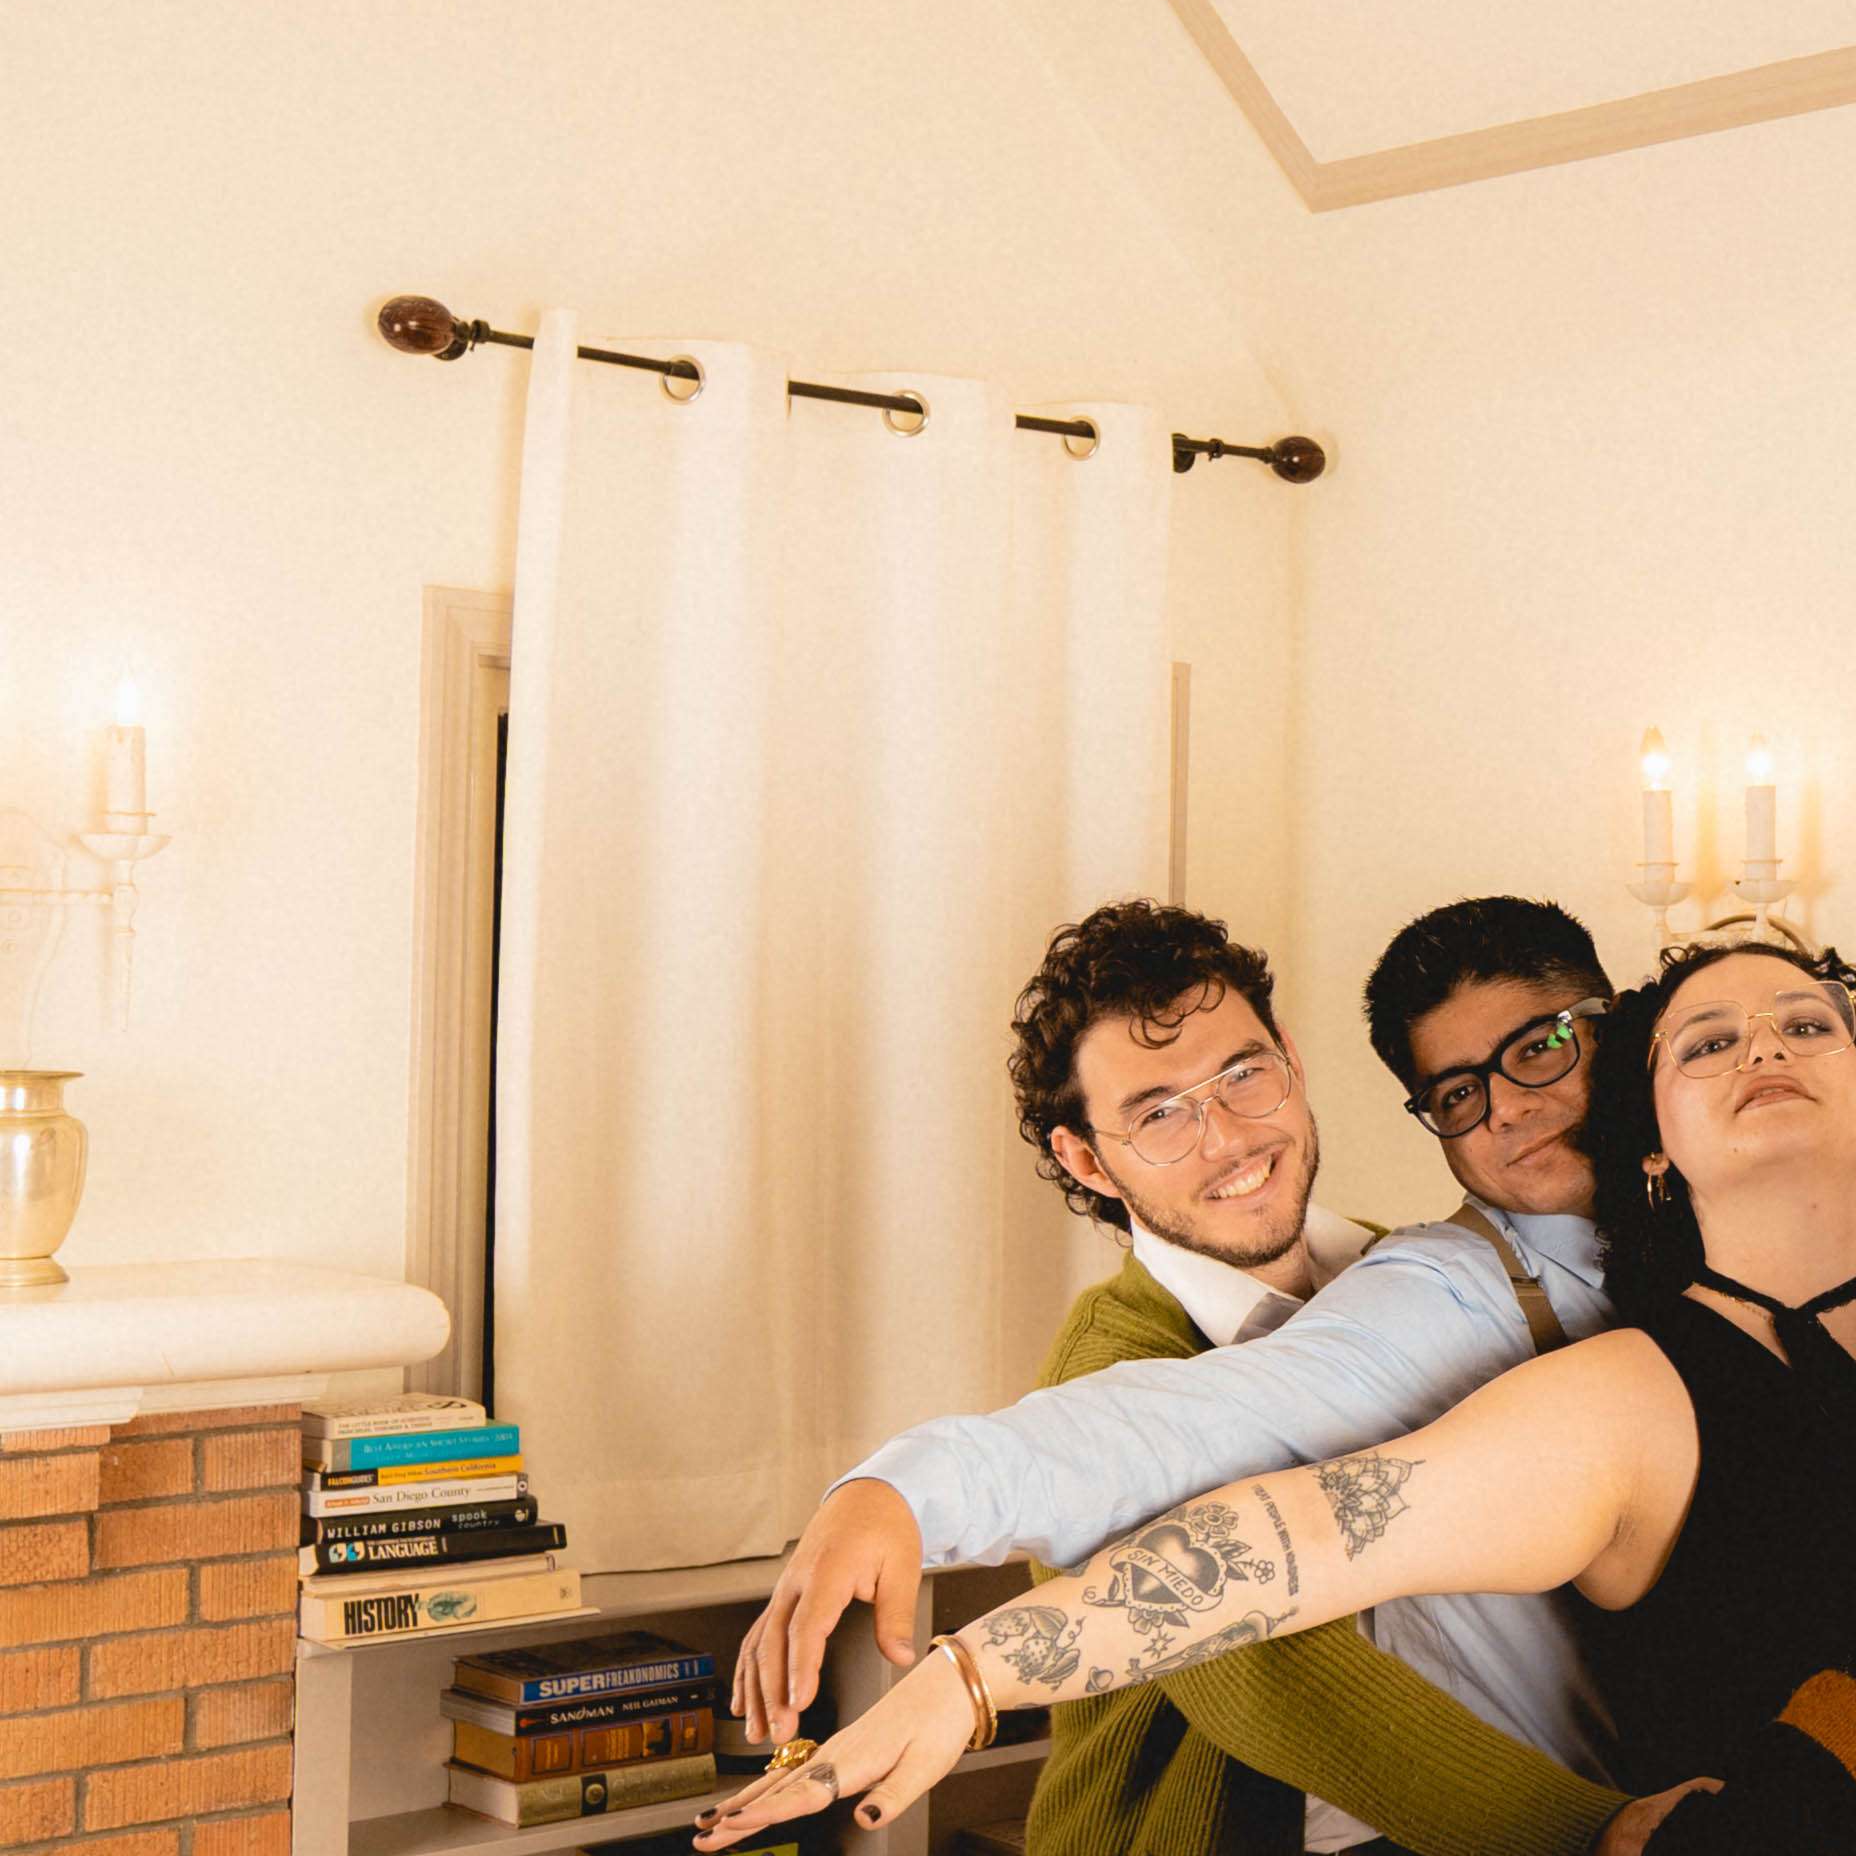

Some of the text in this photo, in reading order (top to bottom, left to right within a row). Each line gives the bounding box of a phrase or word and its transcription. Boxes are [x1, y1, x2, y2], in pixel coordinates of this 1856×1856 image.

[372, 1493, 393, 1505] San
[396, 1489, 428, 1504] Diego
[431, 1485, 472, 1499] County
[451, 1508, 488, 1523] spook
[327, 1518, 442, 1539] WILLIAM GIBSON
[368, 1540, 439, 1561] LANGUAGE
[1127, 1550, 1204, 1606] SIN MIEDO
[343, 1593, 419, 1635] HISTORY
[622, 1701, 641, 1713] NEIL
[642, 1695, 679, 1709] GAIMAN
